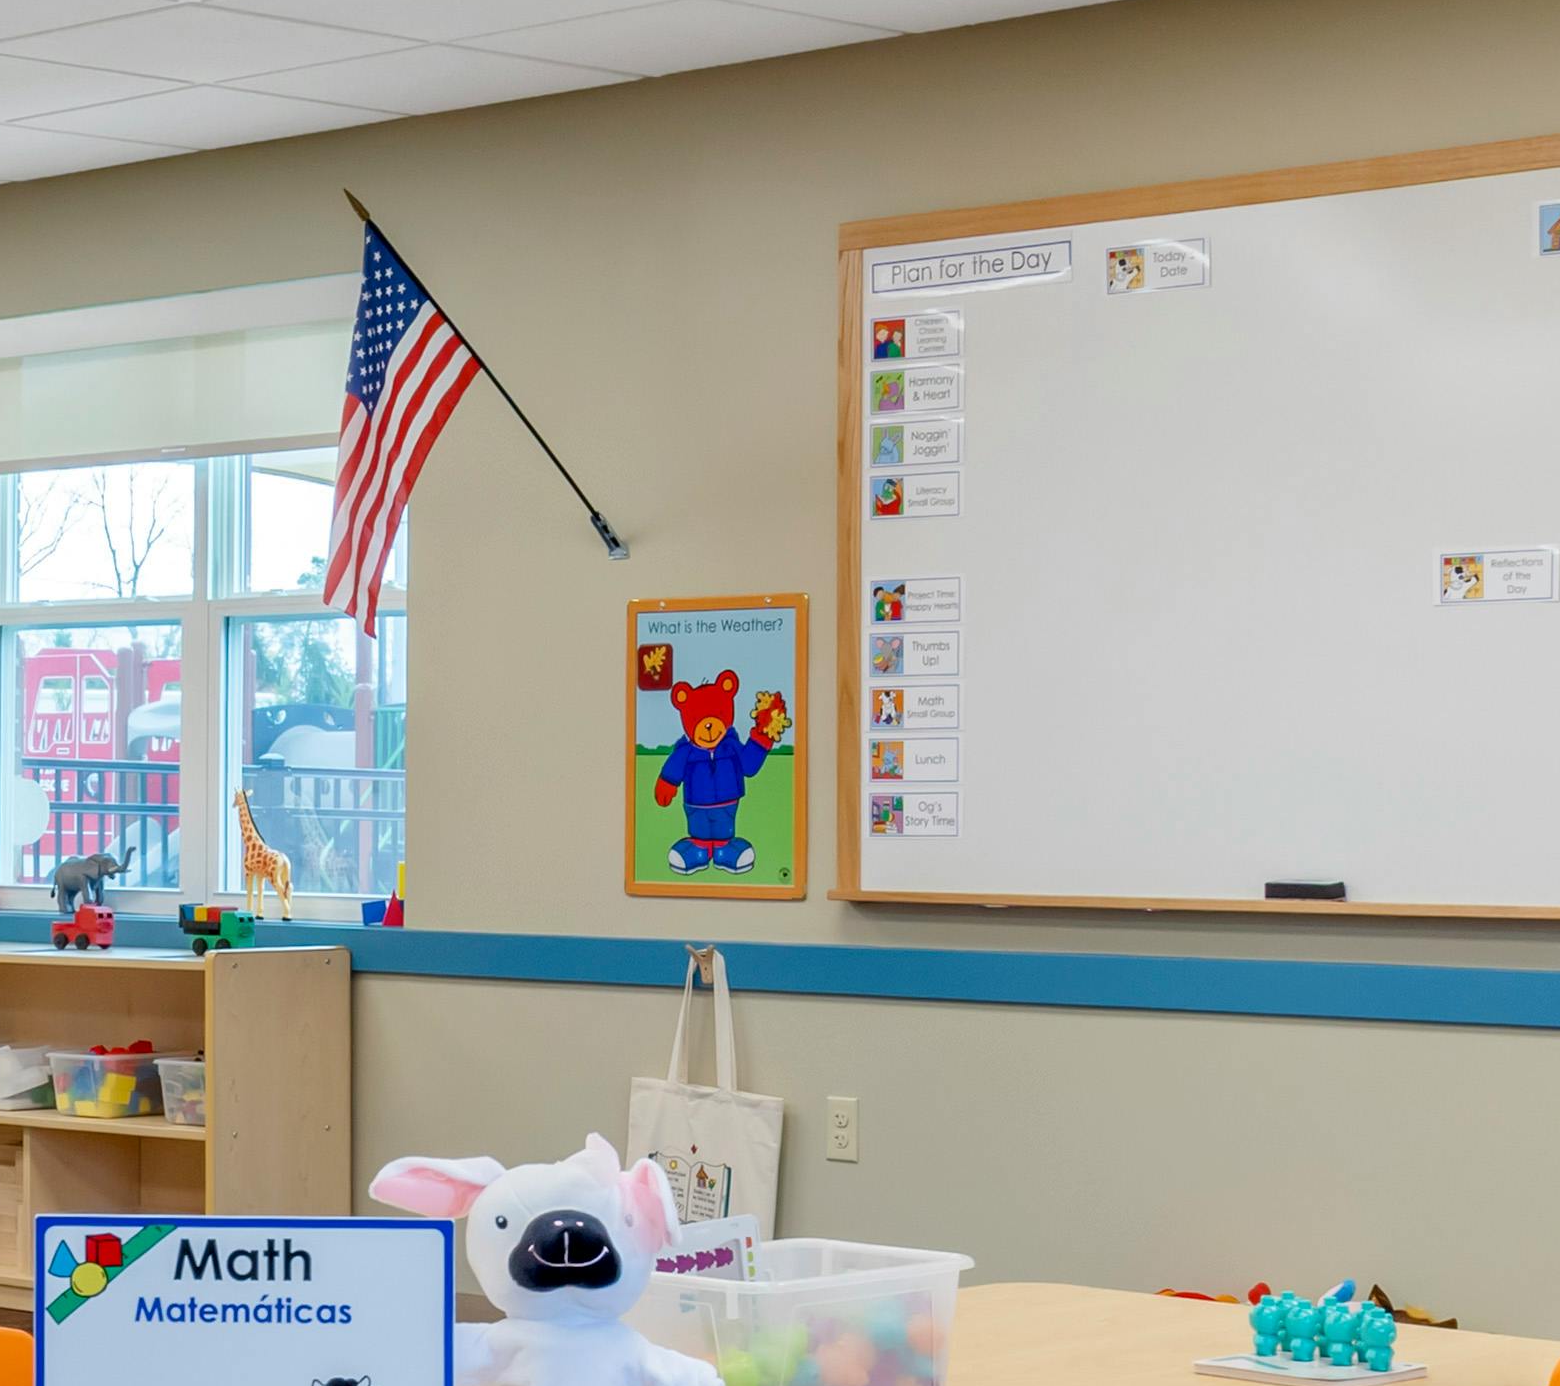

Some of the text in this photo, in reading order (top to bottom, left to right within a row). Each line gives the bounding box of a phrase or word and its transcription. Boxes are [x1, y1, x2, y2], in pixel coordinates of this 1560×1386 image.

[891, 250, 1052, 285] Plan for the Day
[1159, 266, 1188, 278] Date
[908, 374, 955, 389] Harmony
[912, 389, 951, 402] & Heart
[1506, 584, 1528, 595] Day
[648, 618, 784, 635] What is the Weather?
[911, 640, 951, 652] Thumbs
[921, 655, 940, 666] Up!
[917, 696, 945, 707] Math
[914, 754, 946, 765] Lunch
[917, 801, 943, 813] Og's
[905, 815, 956, 828] Story Time
[173, 1238, 312, 1282] Math
[135, 1294, 353, 1324] Matemáticas
